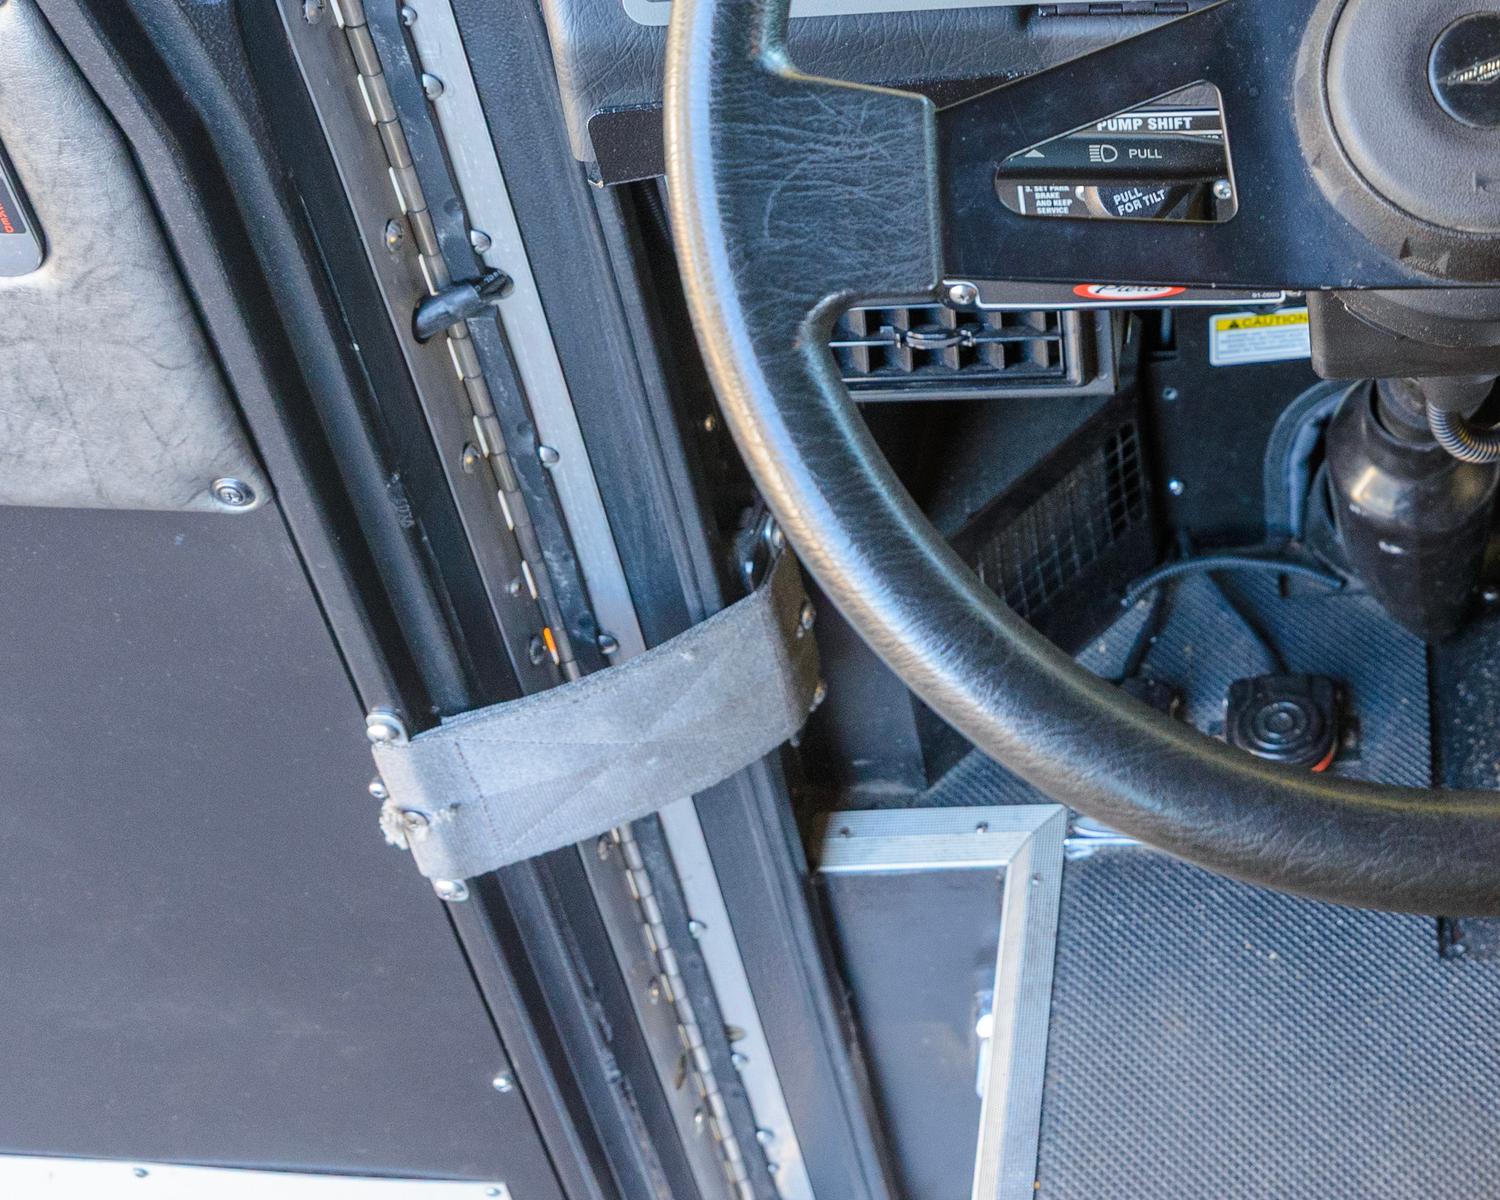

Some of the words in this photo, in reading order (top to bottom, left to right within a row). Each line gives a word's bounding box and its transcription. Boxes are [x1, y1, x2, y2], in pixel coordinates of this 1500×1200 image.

[1097, 118, 1143, 131] PUMP
[1147, 116, 1193, 131] SHIFT
[1128, 148, 1163, 159] PULL
[1113, 188, 1143, 205] PULL
[1118, 198, 1143, 216] FOR
[1143, 189, 1166, 208] TILT
